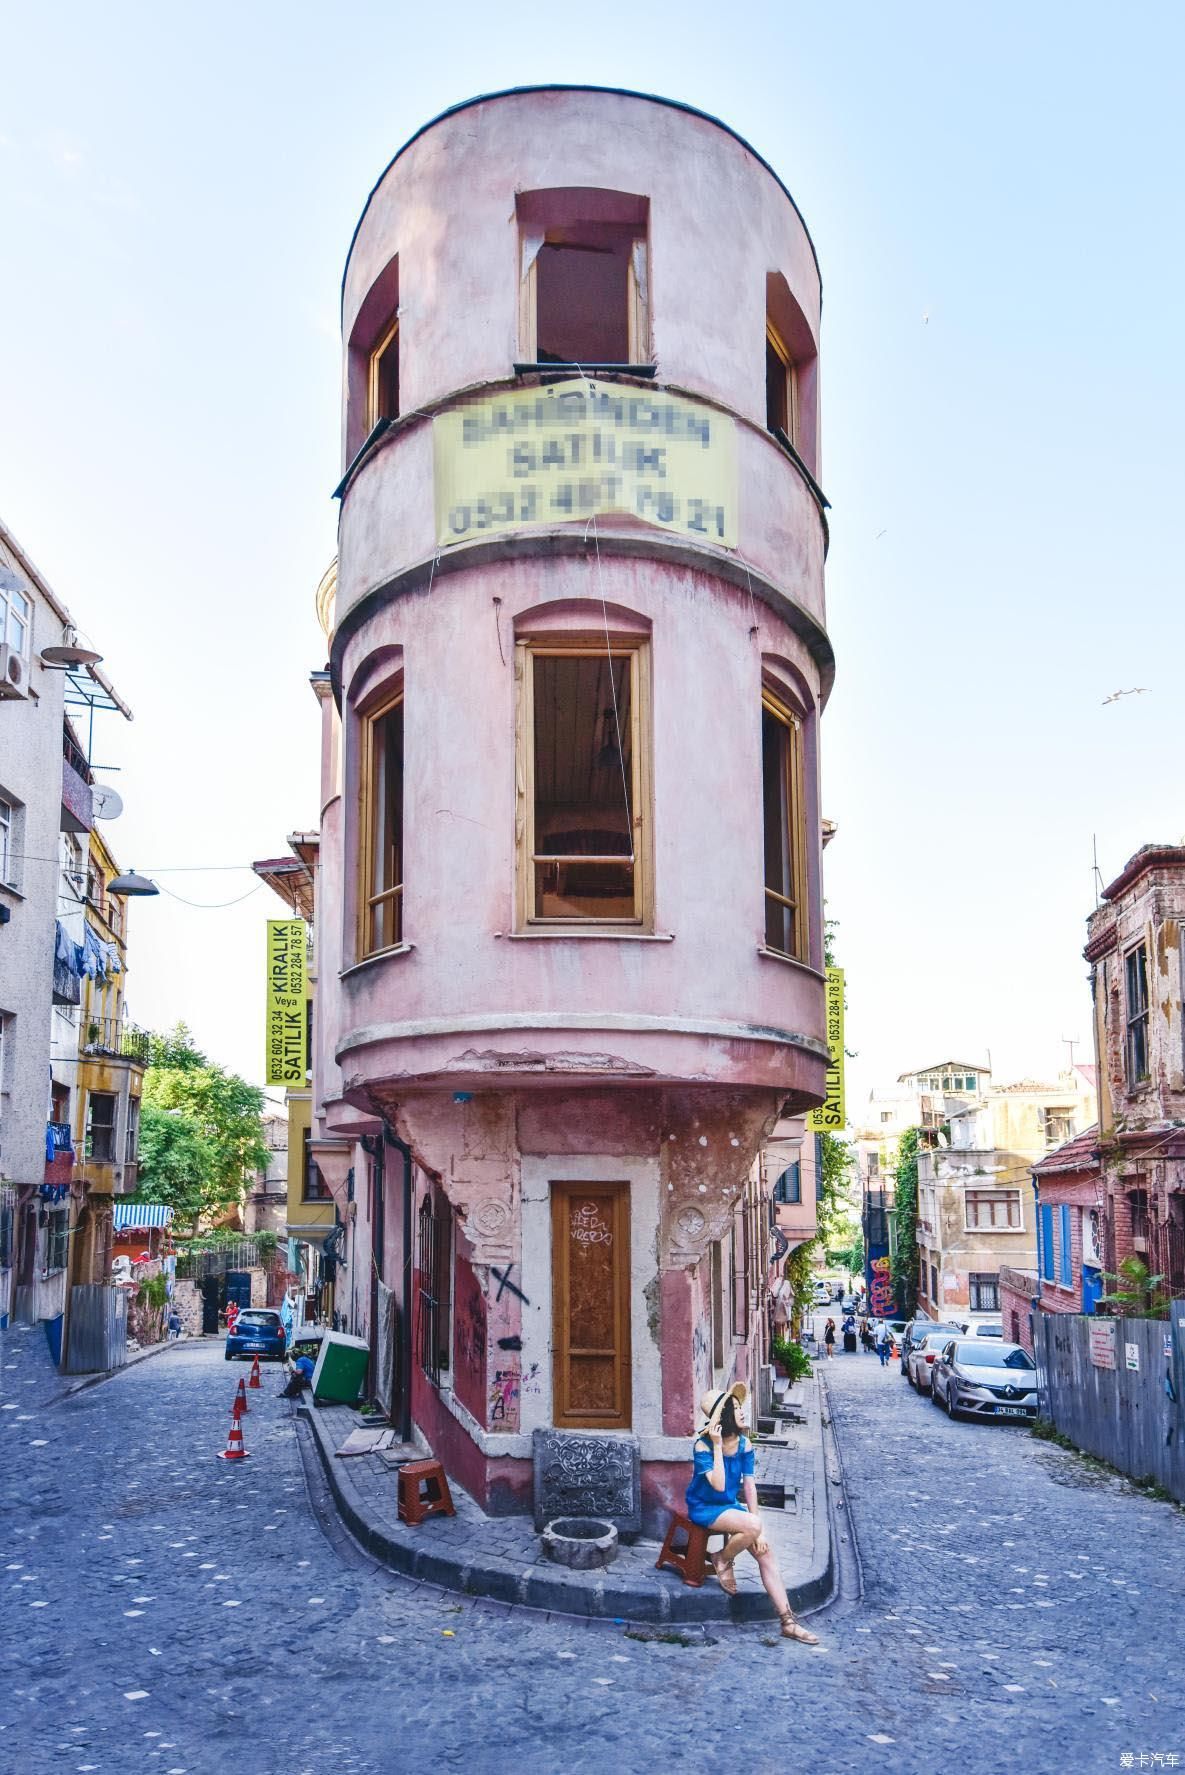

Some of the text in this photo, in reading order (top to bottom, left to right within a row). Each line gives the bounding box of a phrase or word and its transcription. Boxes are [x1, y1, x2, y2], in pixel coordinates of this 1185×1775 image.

[269, 926, 288, 993] KİRALIK
[291, 925, 302, 994] 0532 284 78 57
[275, 996, 297, 1008] Veya
[829, 986, 840, 998] 78
[829, 1000, 840, 1016] 284
[829, 1019, 840, 1041] 0532
[272, 1010, 283, 1080] 0532 602 32 34
[285, 1012, 301, 1080] SATILIK
[813, 1107, 823, 1125] 053
